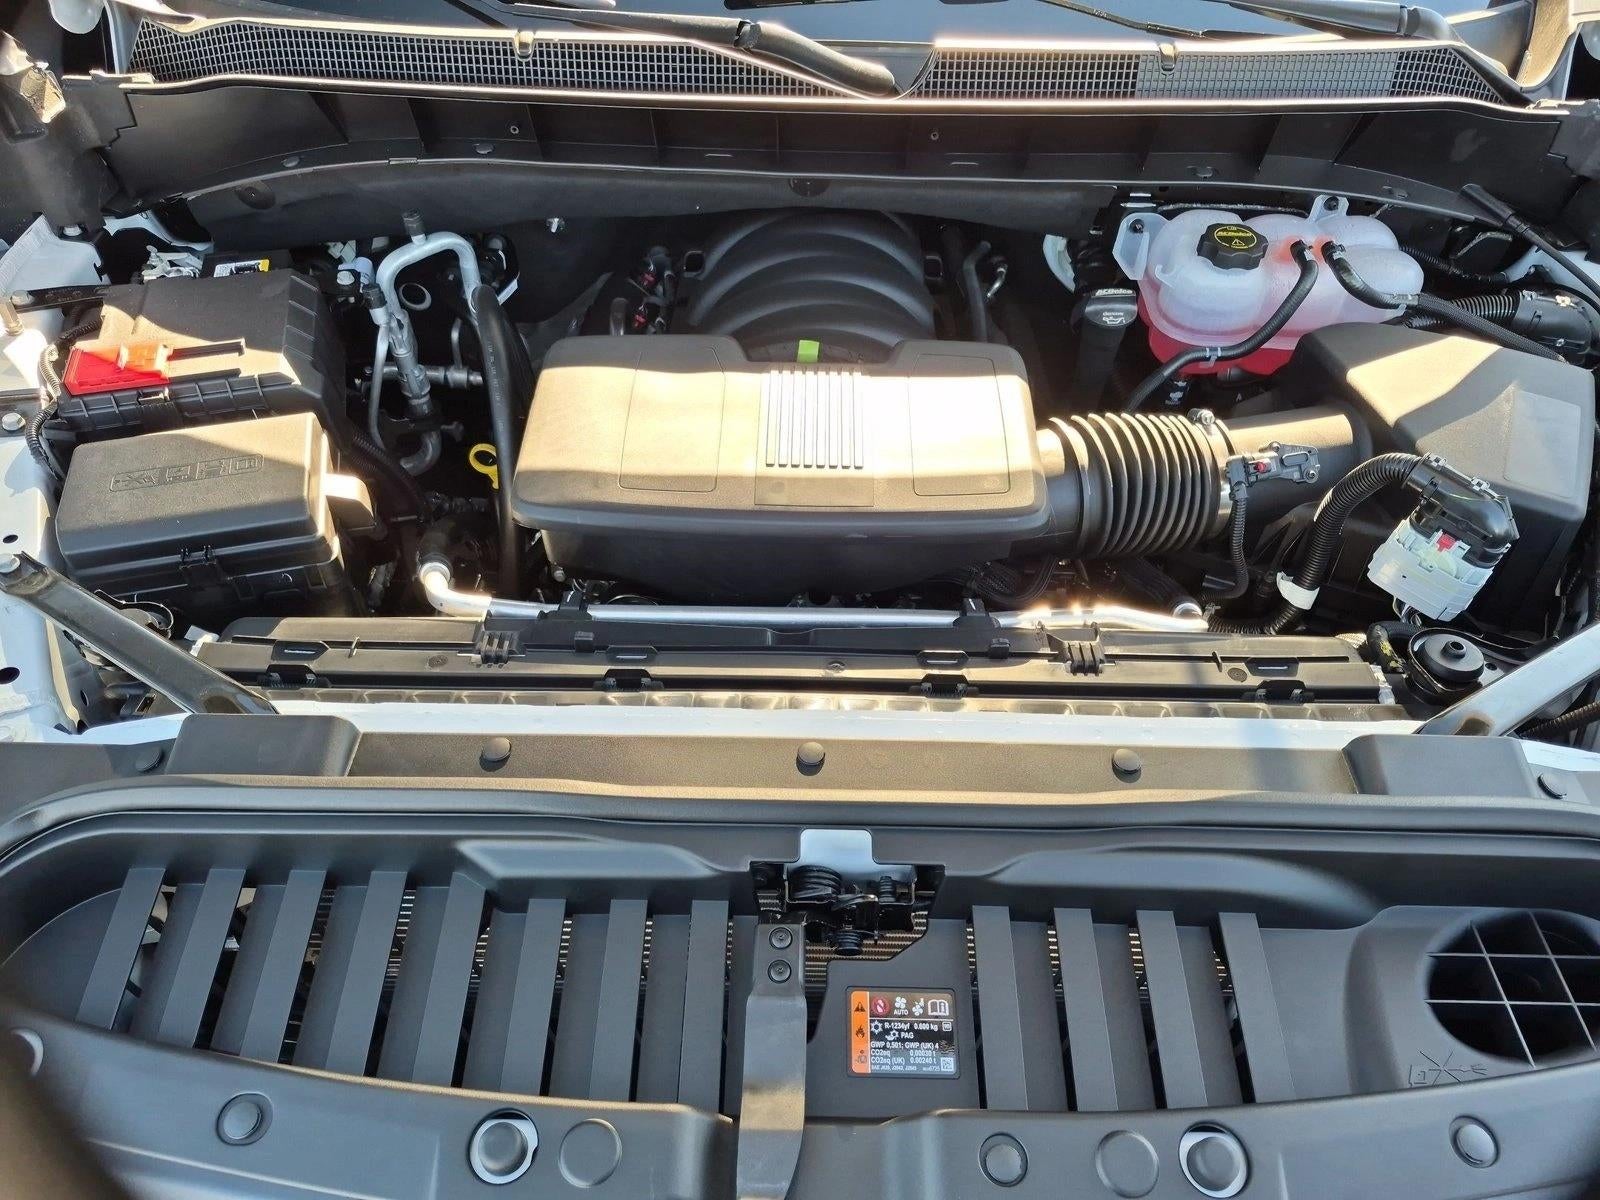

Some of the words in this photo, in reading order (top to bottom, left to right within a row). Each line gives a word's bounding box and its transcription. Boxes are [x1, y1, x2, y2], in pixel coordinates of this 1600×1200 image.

[1095, 288, 1133, 296] ACDelco
[884, 1022, 910, 1030] R-1234yf
[930, 1023, 938, 1031] kg
[920, 1042, 934, 1050] (UK)
